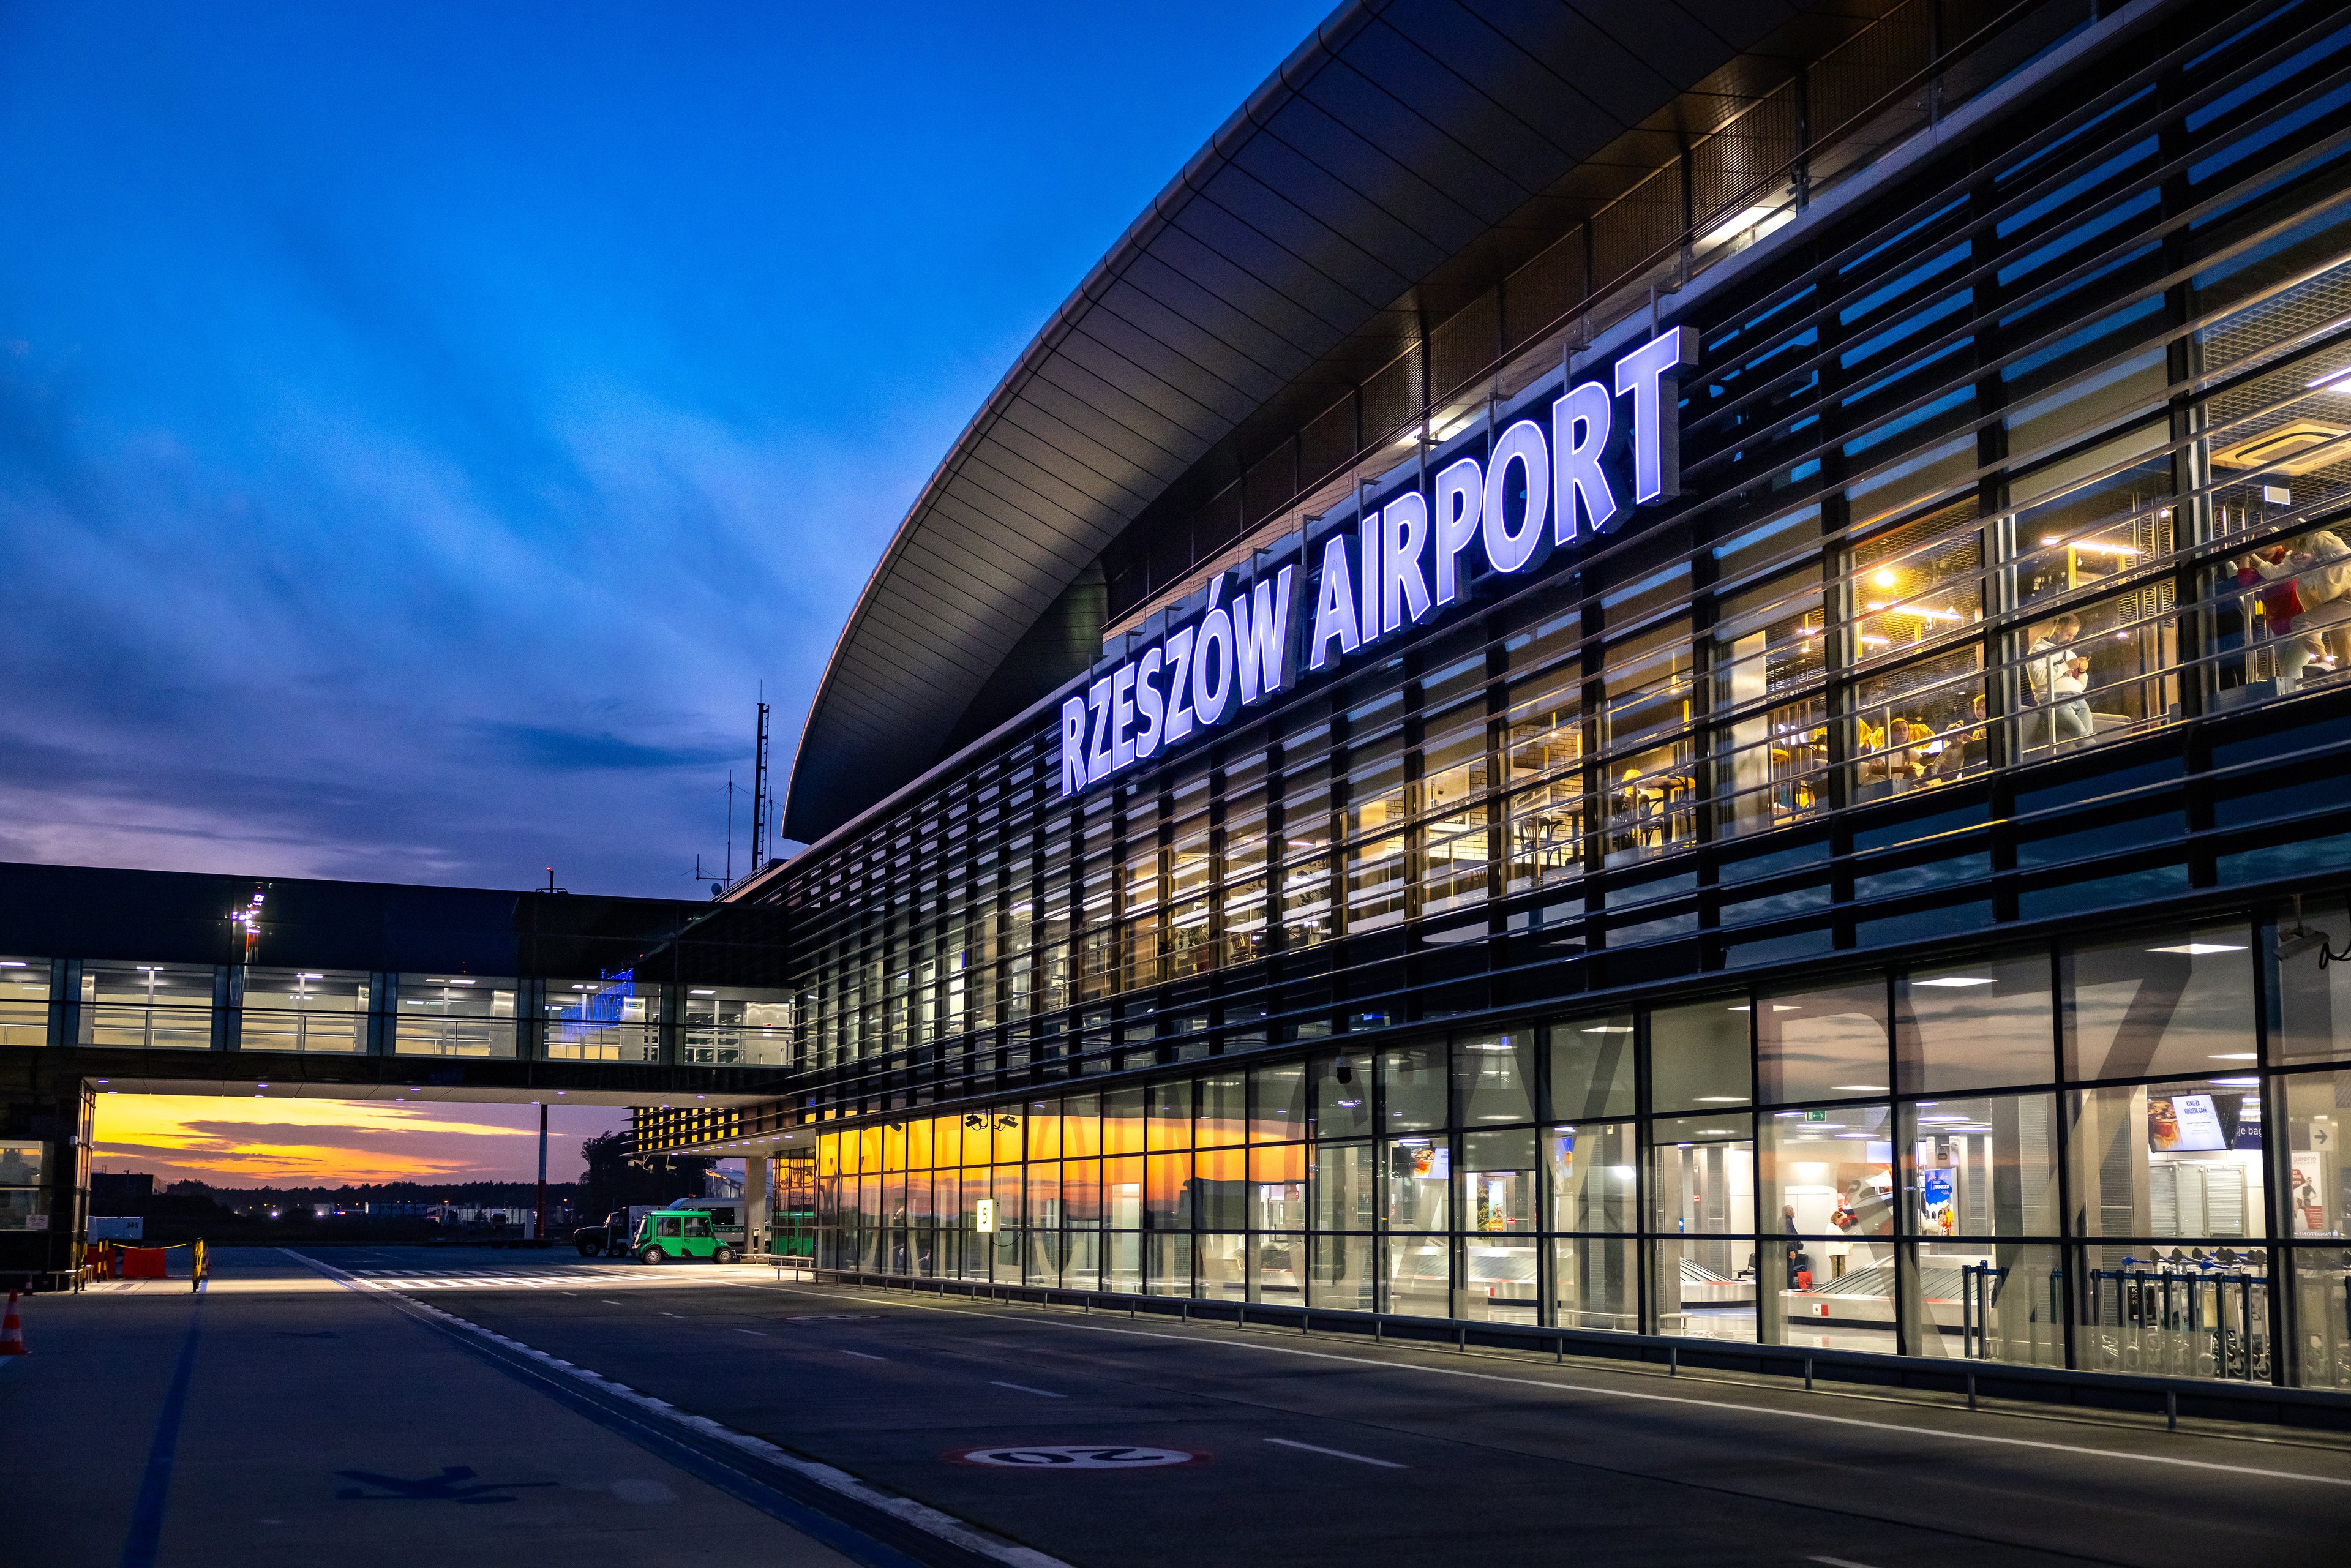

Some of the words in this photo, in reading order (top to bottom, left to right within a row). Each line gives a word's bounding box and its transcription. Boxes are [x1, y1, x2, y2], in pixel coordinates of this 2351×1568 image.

[1061, 563, 1294, 797] RZESZÓW
[1310, 324, 1681, 672] AIRPORT
[2237, 1126, 2246, 1137] je
[983, 1207, 988, 1225] 5
